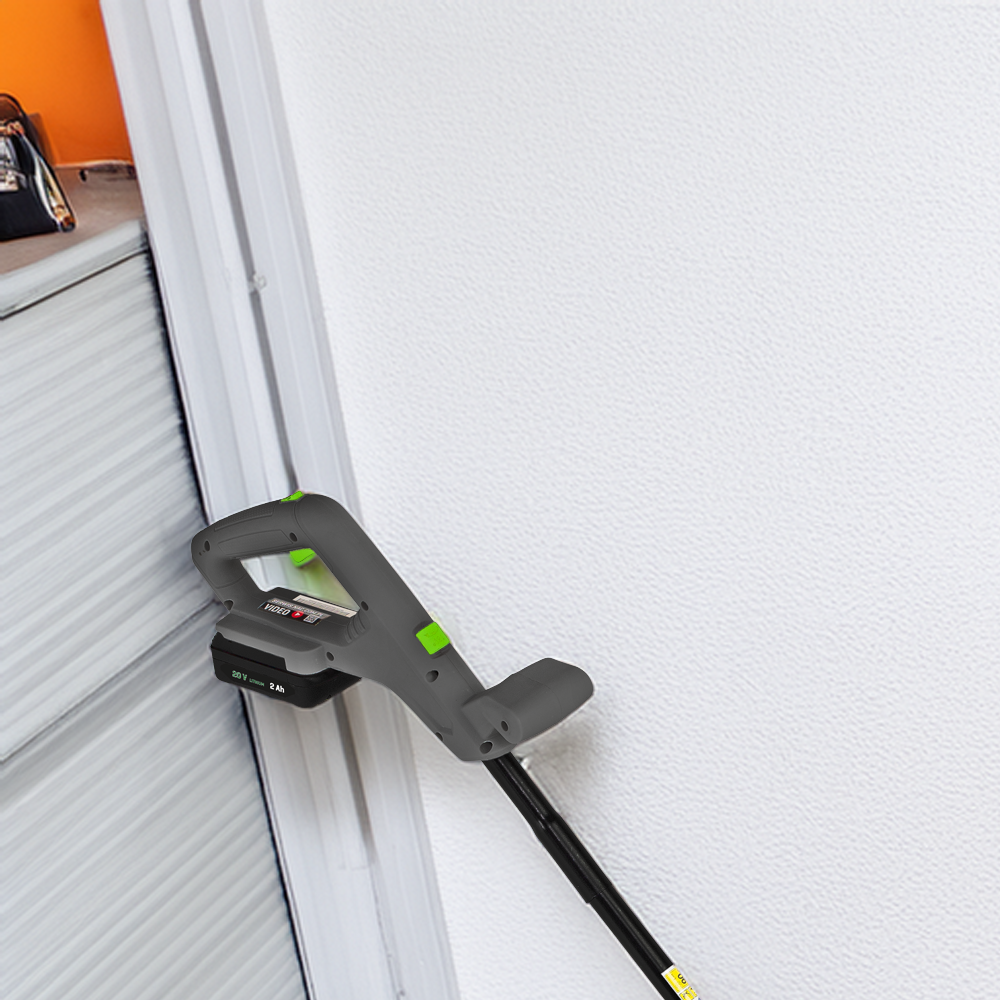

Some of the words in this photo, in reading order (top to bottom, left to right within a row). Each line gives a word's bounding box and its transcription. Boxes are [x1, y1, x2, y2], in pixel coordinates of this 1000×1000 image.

[264, 603, 291, 616] VIDEO
[231, 670, 242, 679] 20
[242, 673, 248, 681] V
[269, 682, 275, 690] 2
[275, 684, 285, 693] Ah
